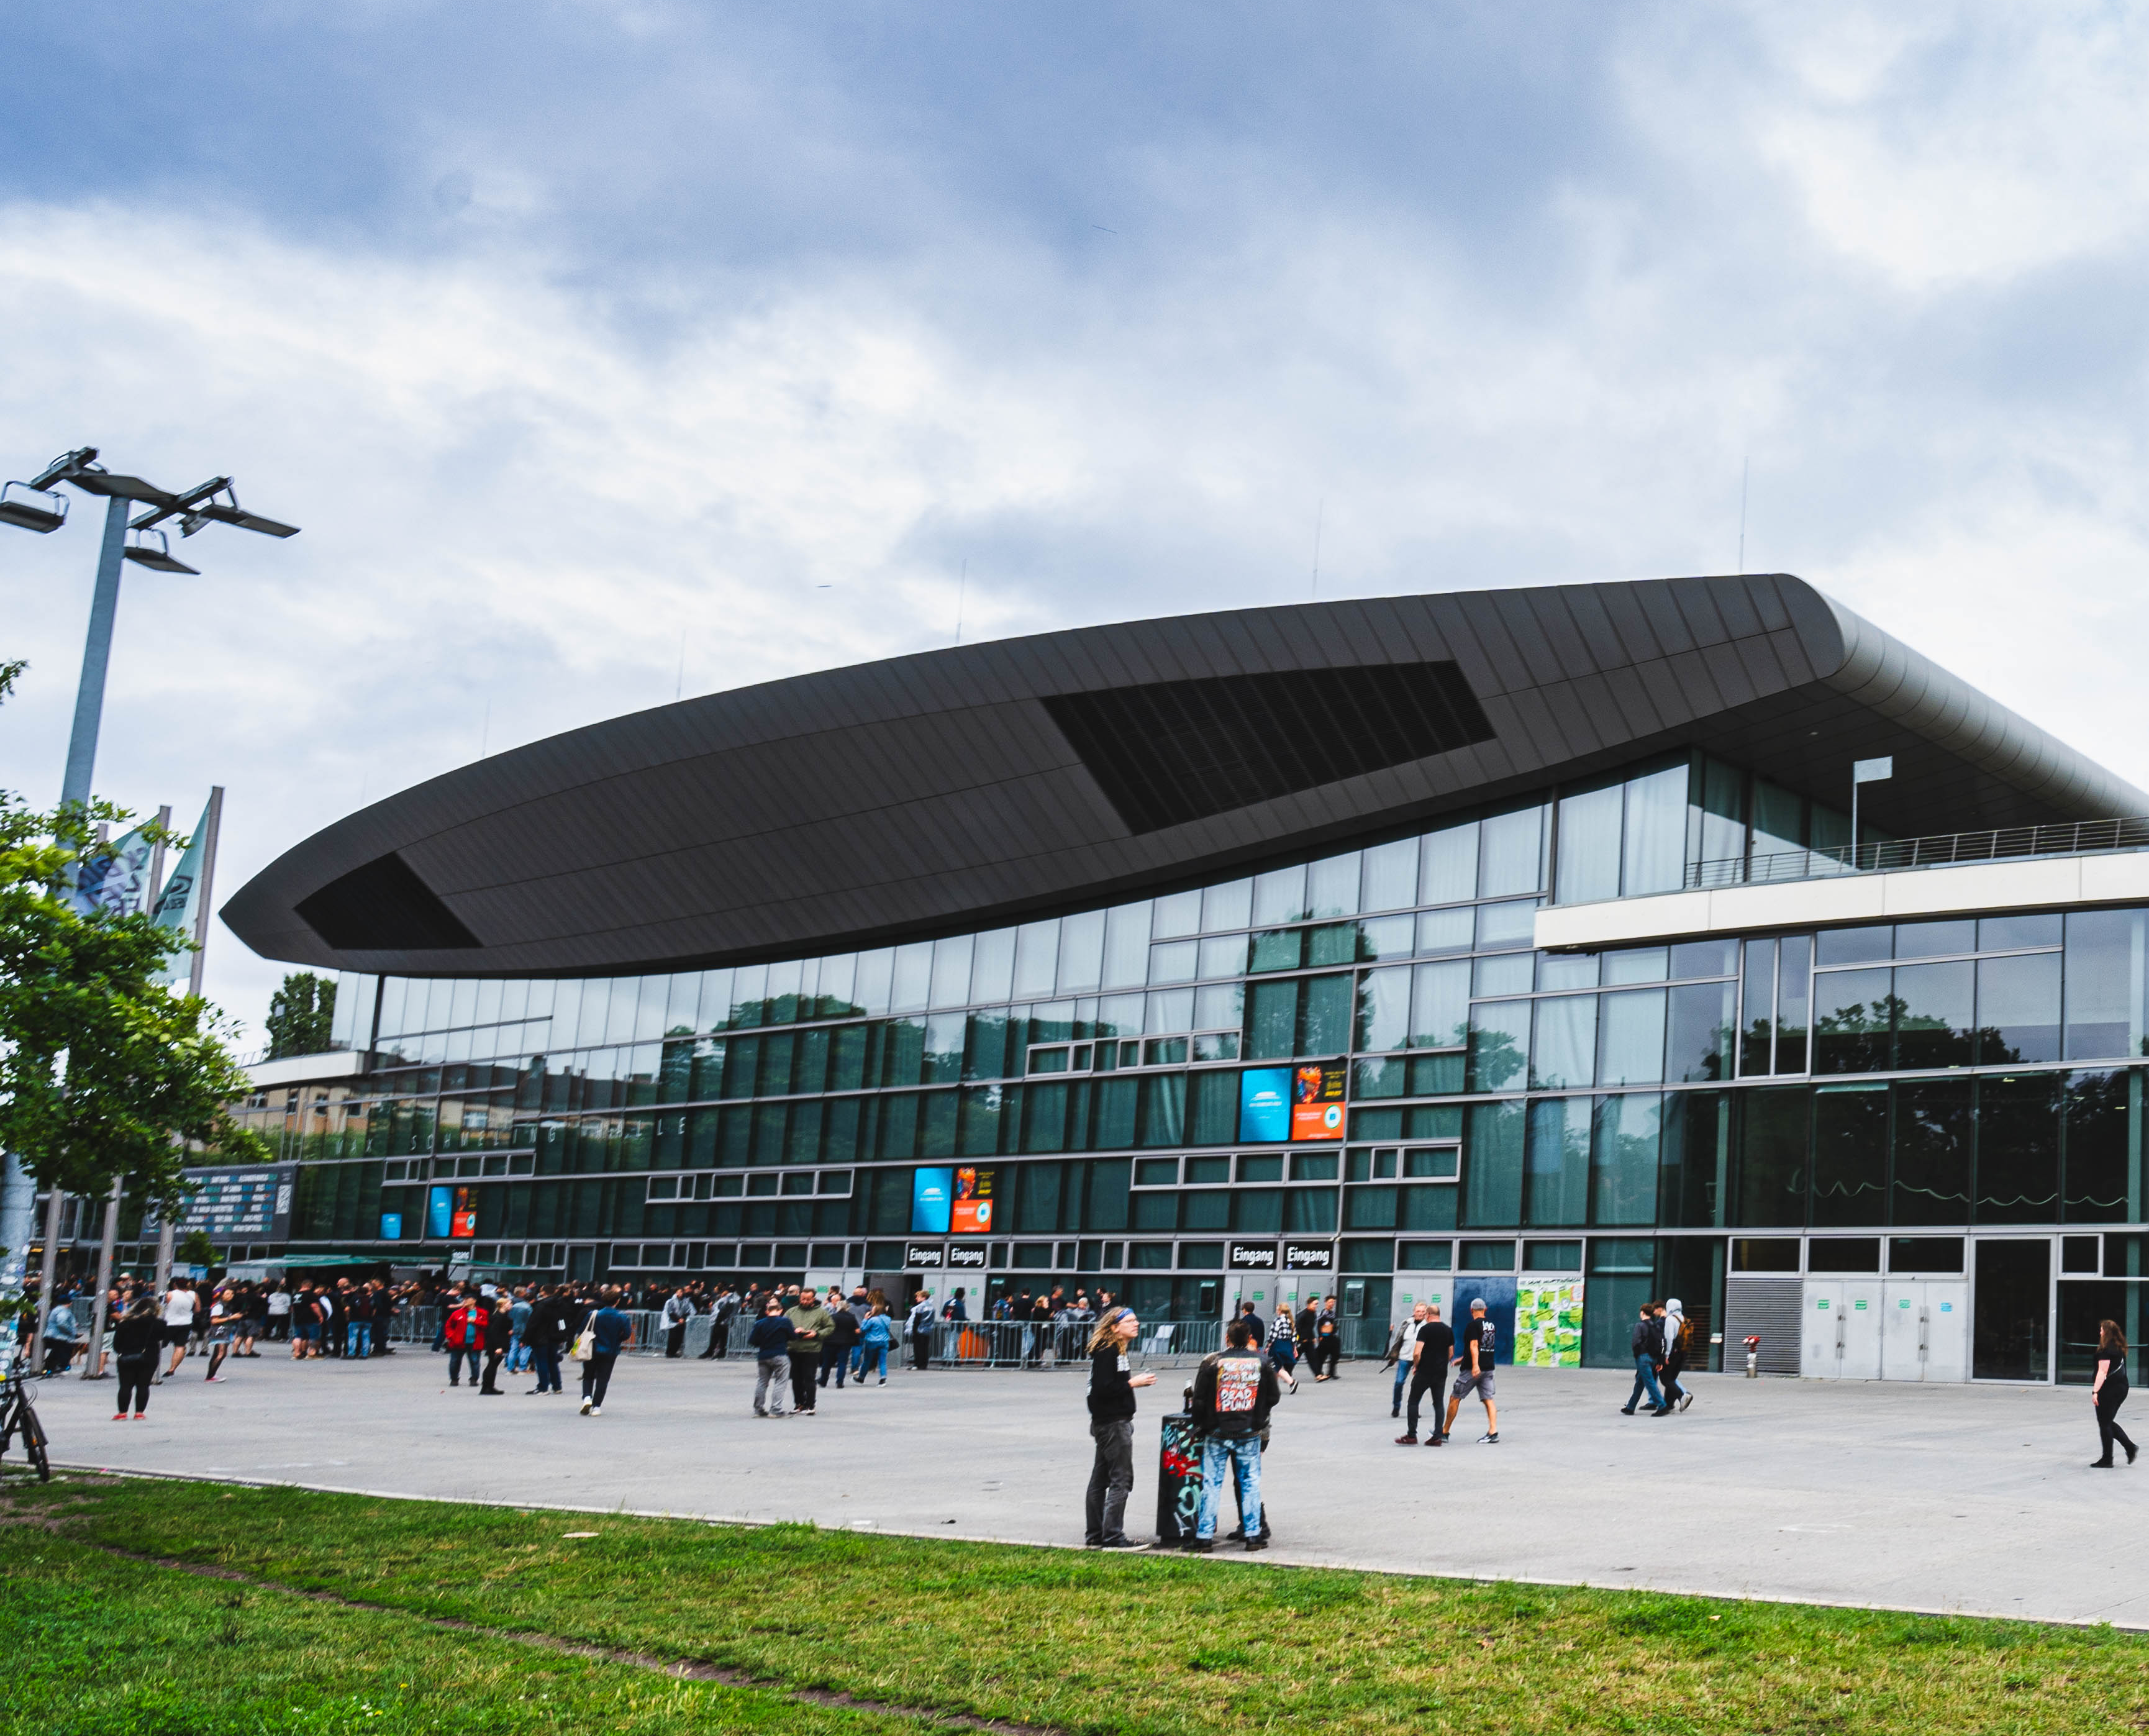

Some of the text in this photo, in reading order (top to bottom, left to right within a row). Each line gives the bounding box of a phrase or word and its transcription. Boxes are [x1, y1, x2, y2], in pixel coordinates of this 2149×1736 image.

[909, 1248, 942, 1265] Eingang
[951, 1248, 984, 1265] Eingang
[1233, 1247, 1274, 1266] Eingang
[1287, 1247, 1330, 1266] Eingang
[1220, 1388, 1252, 1400] DEAD
